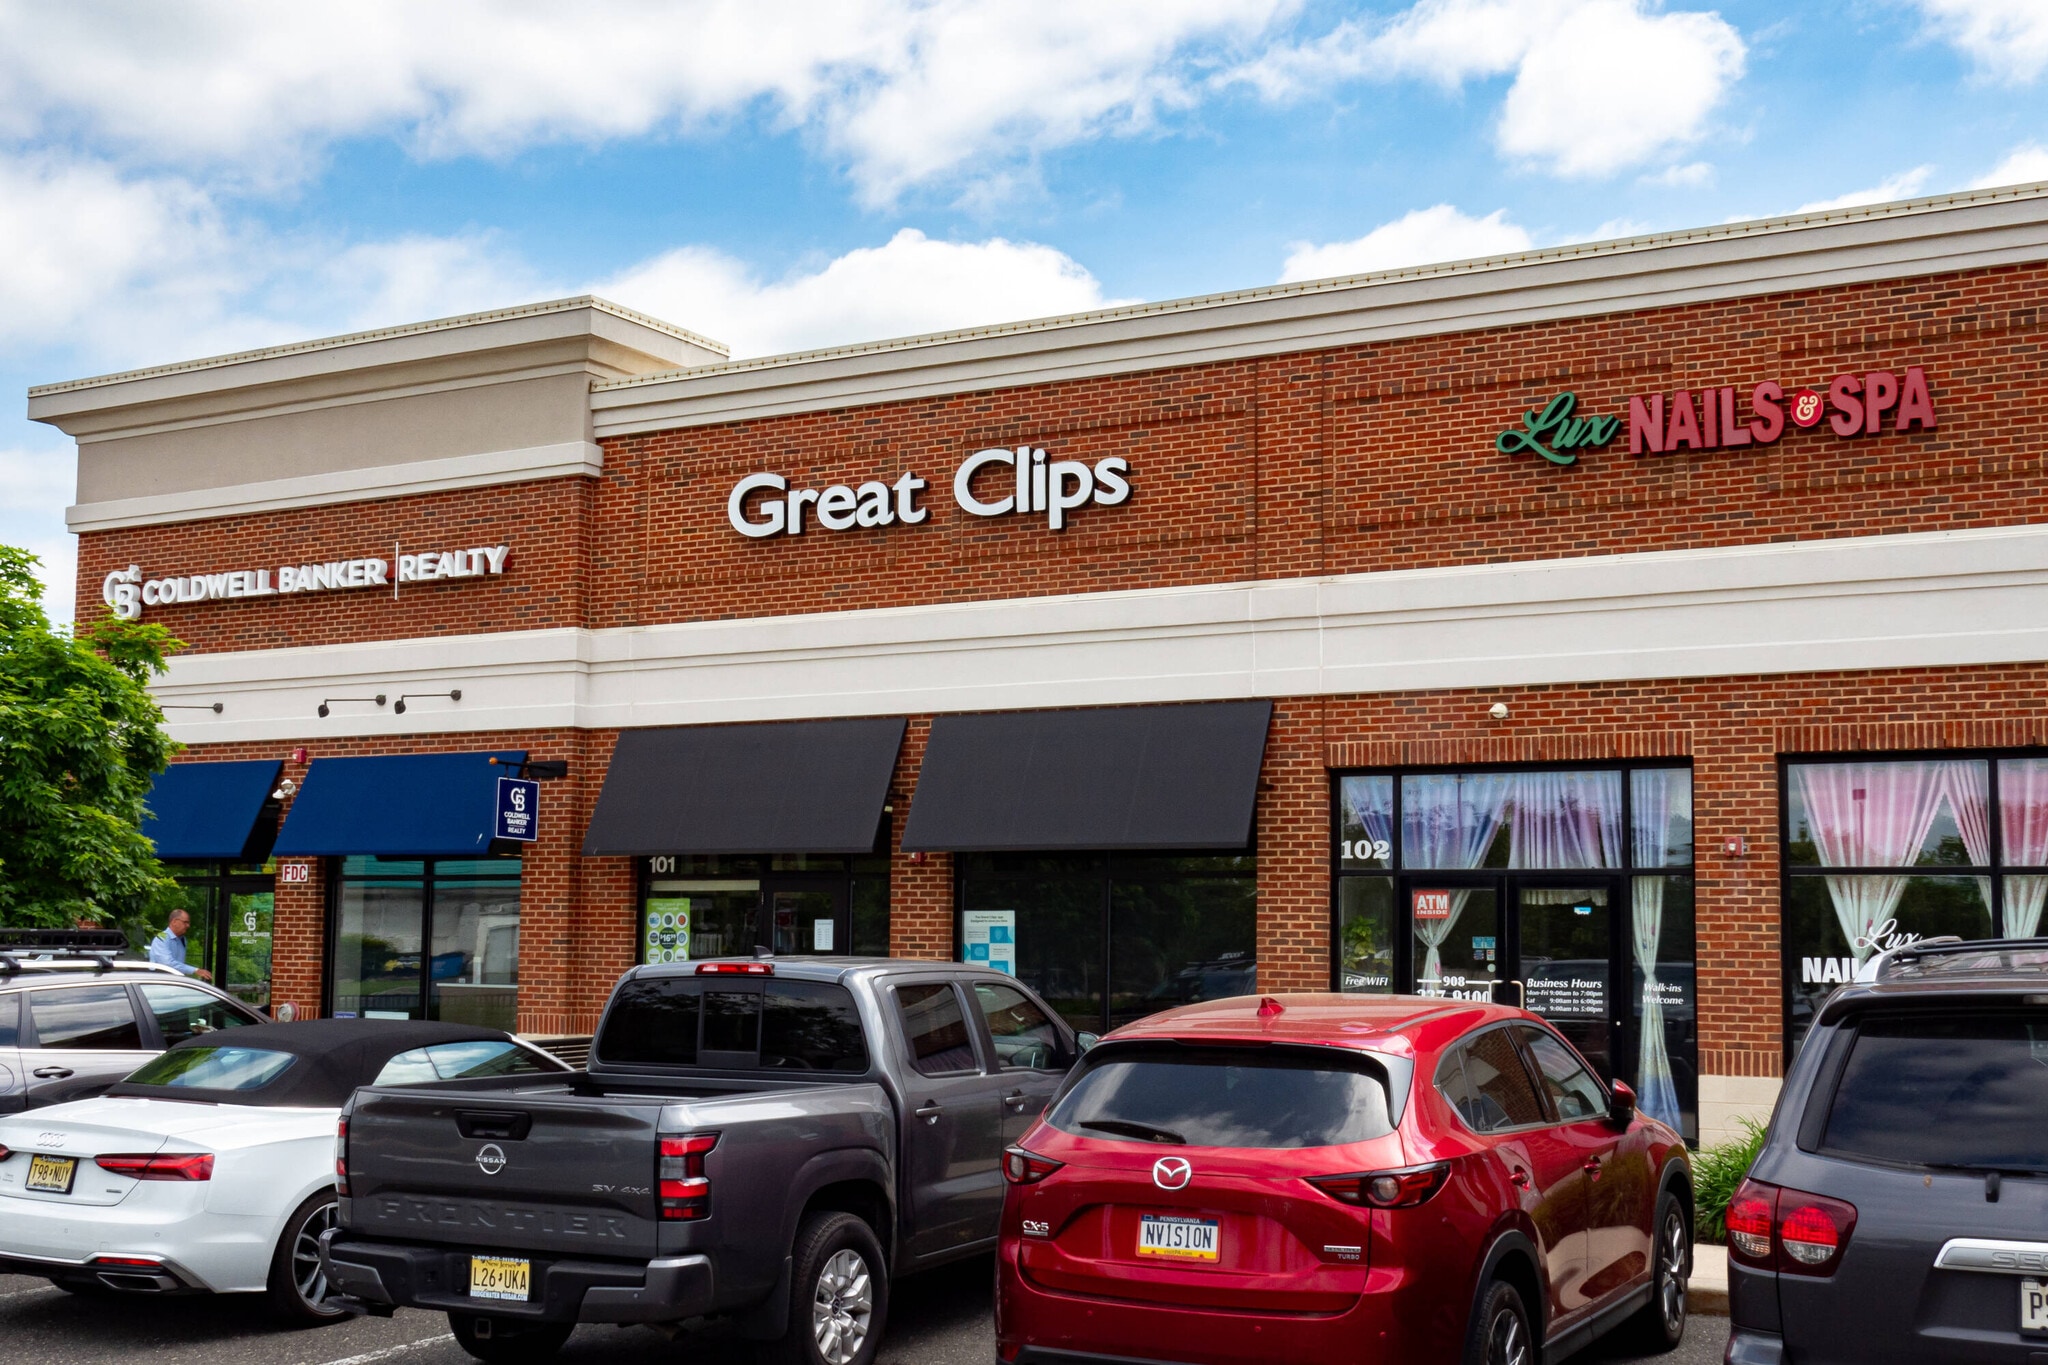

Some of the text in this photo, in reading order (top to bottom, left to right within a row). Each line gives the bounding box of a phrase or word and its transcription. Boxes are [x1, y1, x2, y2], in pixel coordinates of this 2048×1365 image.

[1496, 367, 1936, 465] Lux NAILS & SPA
[728, 446, 1130, 538] Great Clips
[142, 569, 277, 606] COLDWELL
[278, 558, 389, 593] BANKER
[399, 545, 510, 581] REALTY
[504, 811, 531, 820] COLDWELL
[507, 818, 527, 826] BANKER
[1341, 840, 1390, 859] 102
[649, 856, 675, 873] 101
[283, 865, 307, 881] FDC
[1417, 894, 1448, 910] ATM
[1854, 918, 1923, 953] Lux
[1345, 976, 1389, 986] Free WIFI
[1442, 976, 1466, 987] 908
[1526, 977, 1603, 989] Business Hours
[1643, 983, 1683, 993] Walk-ins
[1642, 995, 1684, 1005] Welcome
[1526, 1005, 1547, 1013] Sunday
[475, 1156, 506, 1164] NISSAN
[592, 1184, 616, 1193] SV
[1022, 1219, 1049, 1231] CX-5
[1159, 1215, 1200, 1224] PENNSYLVANIA
[1992, 1251, 2048, 1272] SE
